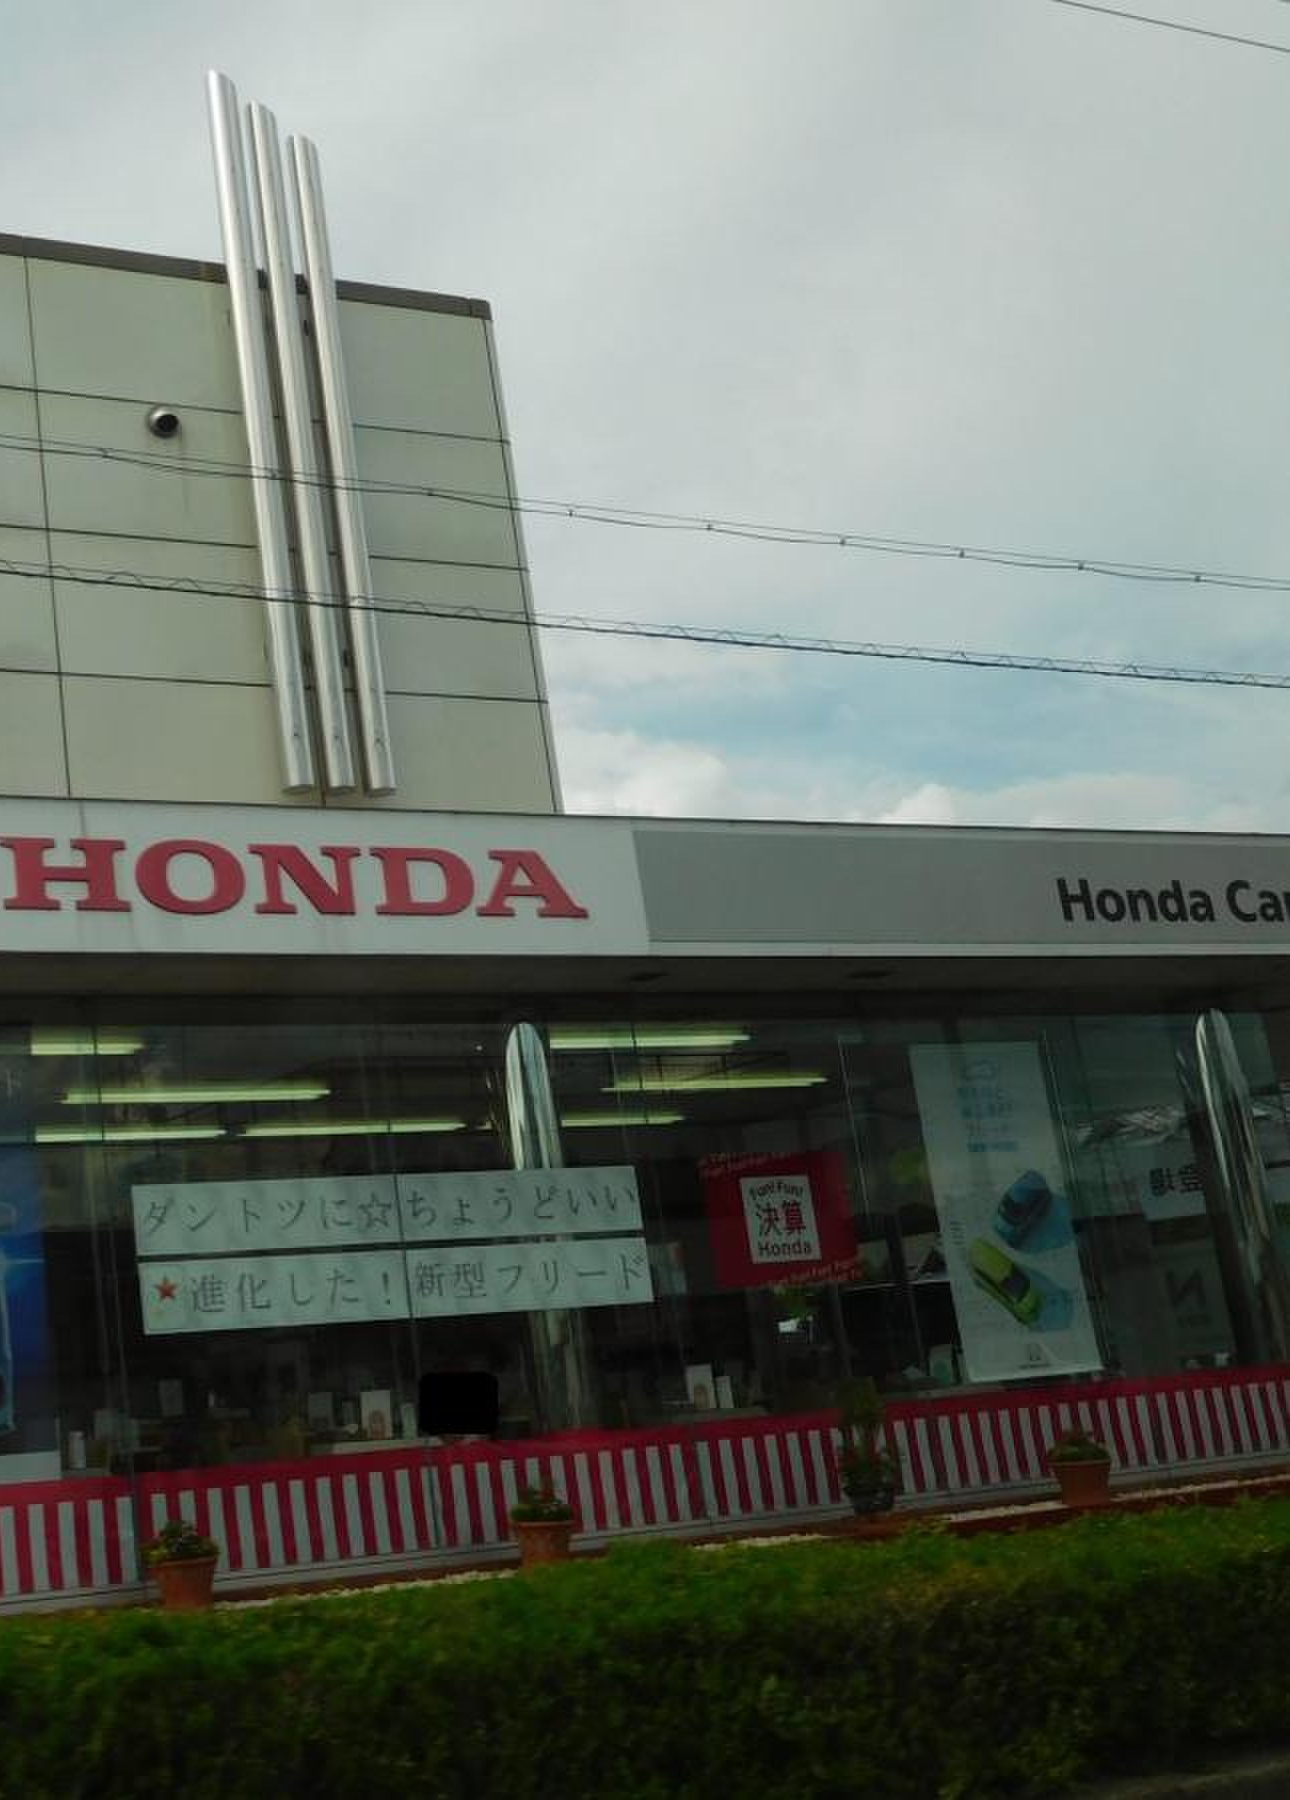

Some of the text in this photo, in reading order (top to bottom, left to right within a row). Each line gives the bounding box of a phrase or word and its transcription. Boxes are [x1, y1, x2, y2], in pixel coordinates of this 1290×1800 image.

[1057, 877, 1215, 923] Honda
[756, 1200, 806, 1236] 決算
[758, 1240, 811, 1257] Honda
